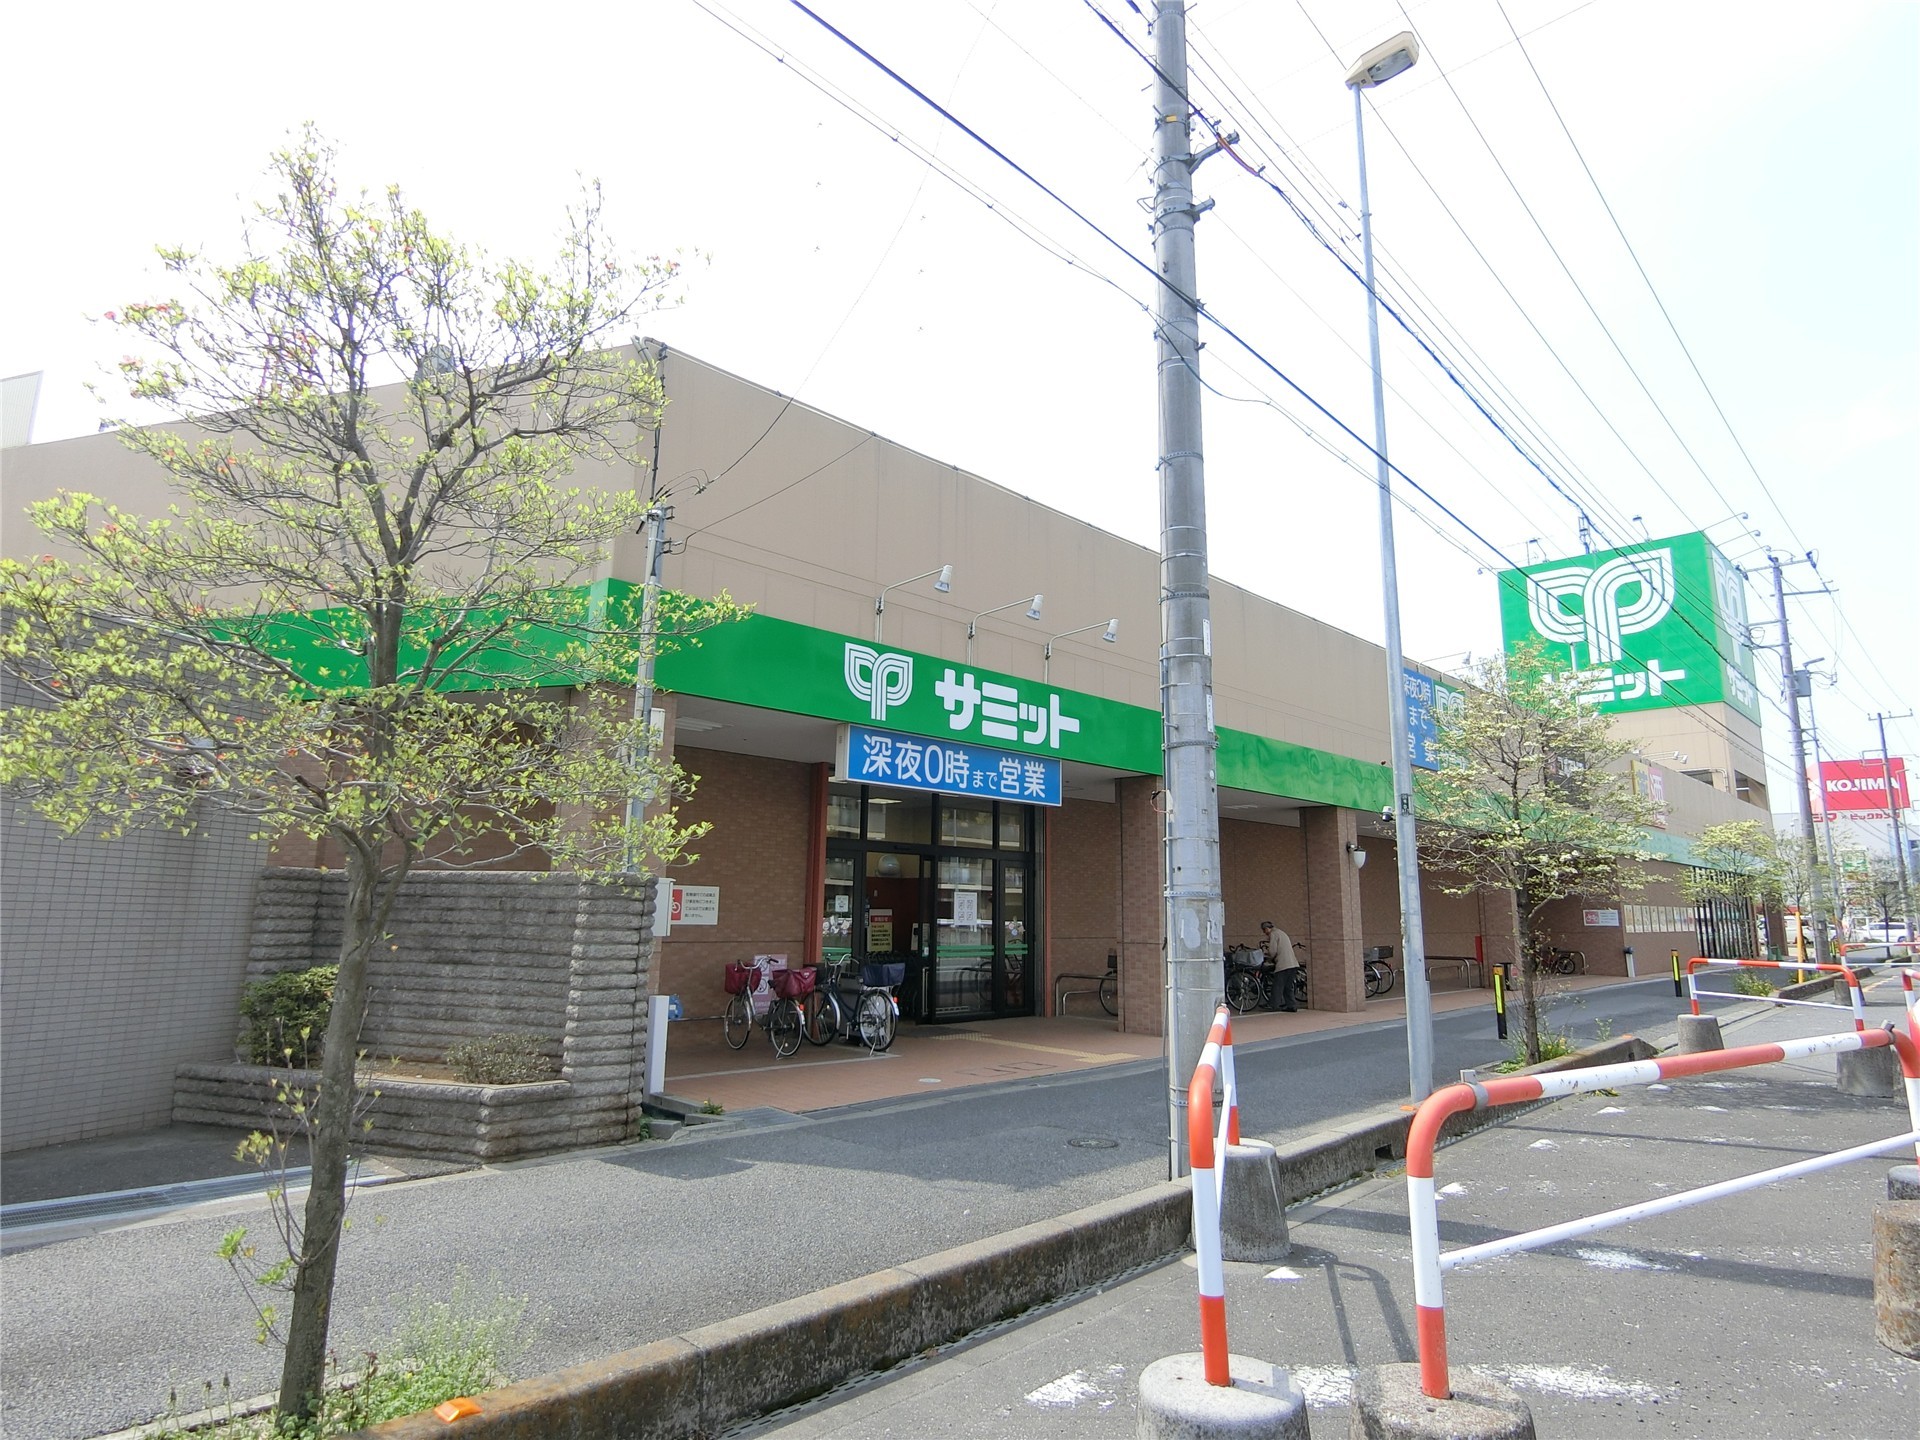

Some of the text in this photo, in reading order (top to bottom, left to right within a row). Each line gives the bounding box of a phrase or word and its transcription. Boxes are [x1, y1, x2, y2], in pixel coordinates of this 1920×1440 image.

[935, 668, 1080, 749] サミット
[1541, 658, 1686, 706] ミット
[862, 734, 1046, 798] 深夜0時まで営業
